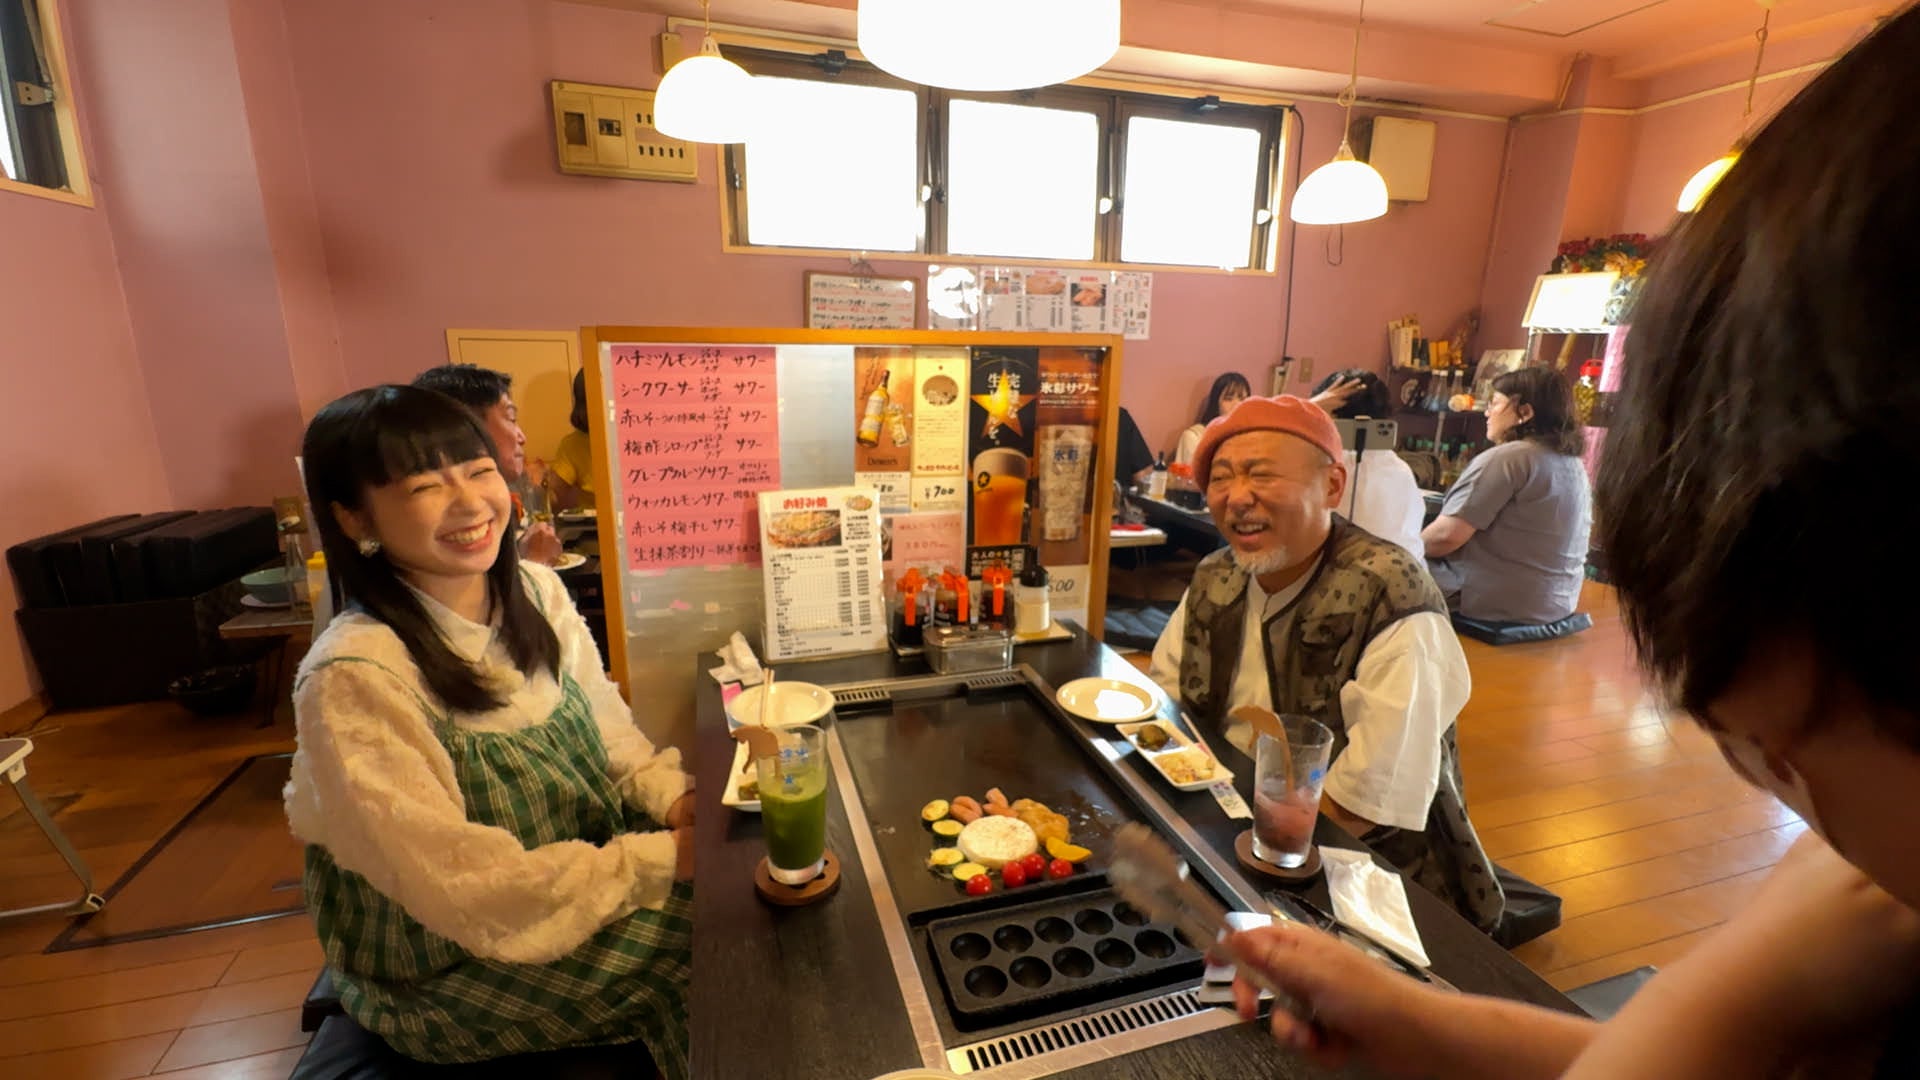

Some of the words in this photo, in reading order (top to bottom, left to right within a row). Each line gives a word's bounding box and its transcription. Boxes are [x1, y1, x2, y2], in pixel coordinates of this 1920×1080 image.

[734, 355, 767, 368] サワー
[621, 381, 695, 398] シークワーサー
[734, 381, 767, 395] サワー
[1040, 381, 1100, 394] 氷彩サワー
[620, 408, 654, 428] 赤しそ
[740, 410, 768, 423] サワー
[736, 438, 763, 453] サワー
[782, 496, 829, 510] お好み焼
